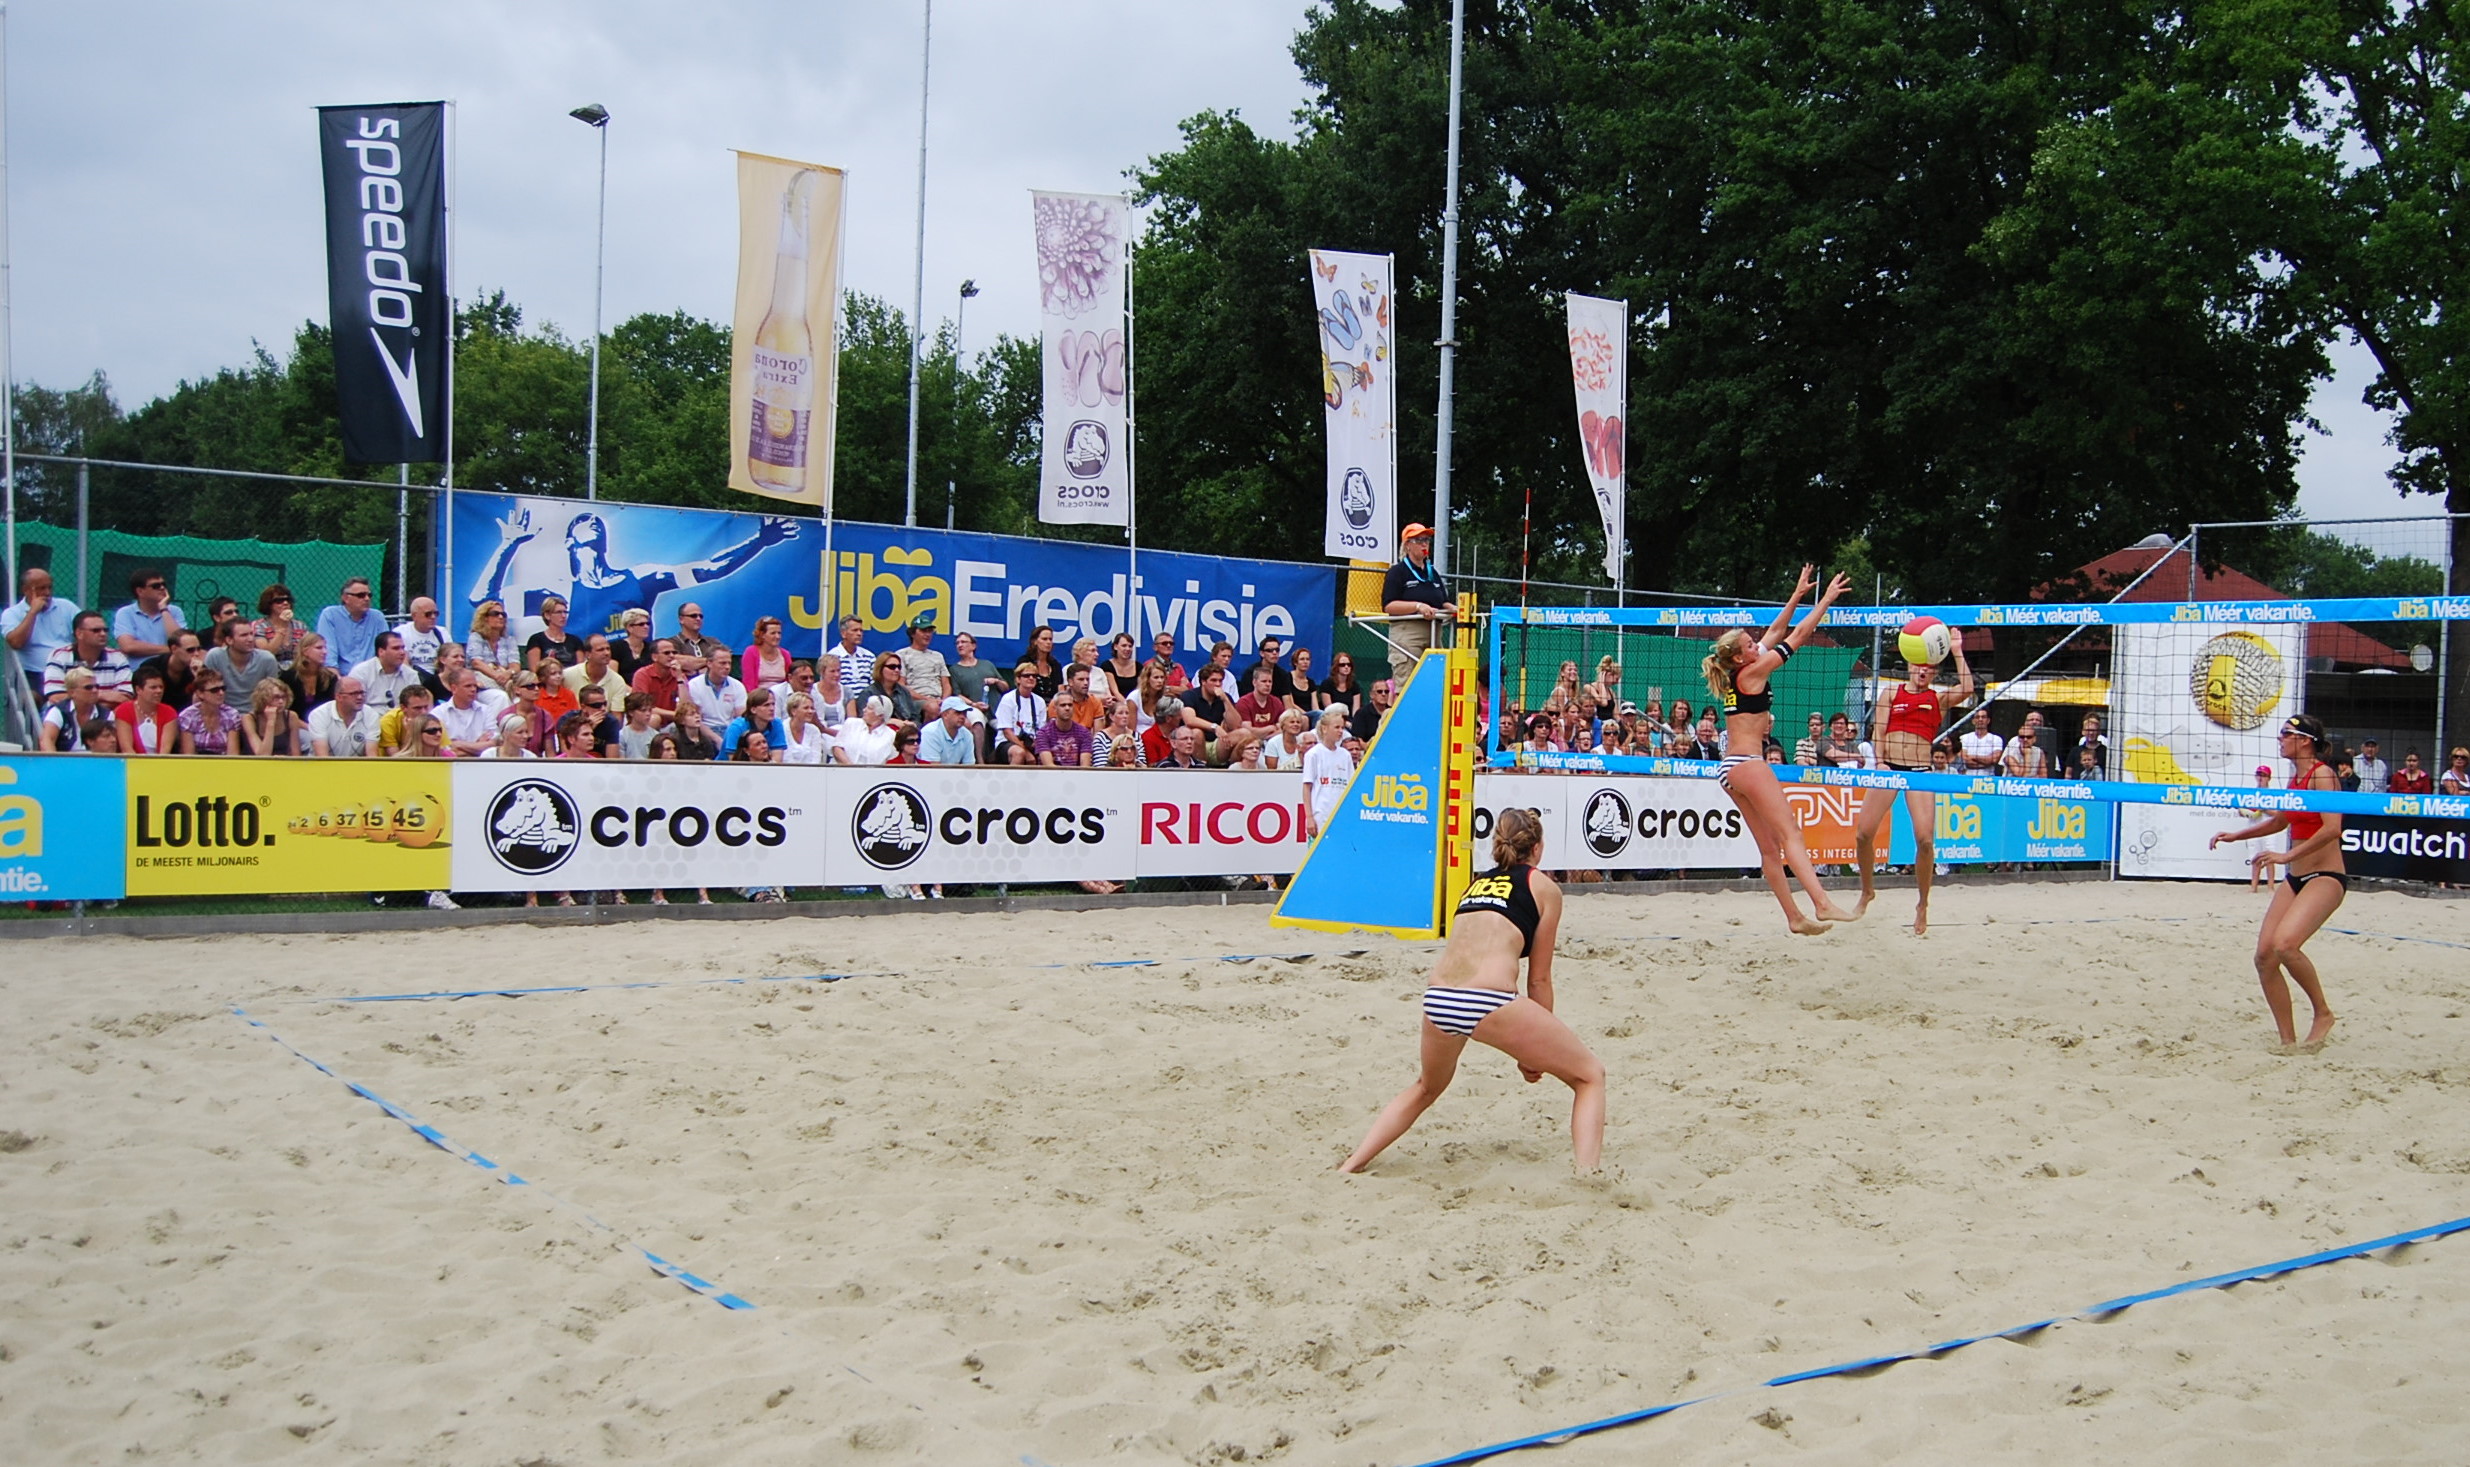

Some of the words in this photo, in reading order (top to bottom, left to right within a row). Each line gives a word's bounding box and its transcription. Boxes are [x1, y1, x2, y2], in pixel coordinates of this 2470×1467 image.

[346, 117, 424, 328] speedo
[789, 546, 951, 637] Jiba
[953, 559, 1296, 657] Eredivisie
[1570, 610, 1613, 624] vakantie.
[1680, 609, 1706, 625] Méér
[1708, 609, 1756, 625] vakantie.
[1833, 609, 1862, 624] Méér
[2005, 607, 2038, 624] Méér
[2042, 607, 2104, 624] vakantie.
[2204, 604, 2243, 622] Méér
[2245, 603, 2317, 621] vakantie.
[1564, 756, 1606, 770] vakantie.
[1673, 760, 1701, 776] Méér
[1825, 769, 1855, 786] Méér
[1856, 772, 1910, 789] vakantie.
[1361, 773, 1428, 811] Jiba
[1997, 779, 2031, 796] Méér
[2033, 781, 2095, 800] vakantie.
[2195, 788, 2236, 807] Méér
[2237, 791, 2307, 810] vakantie.
[1360, 809, 1385, 822] Méér
[1386, 811, 1429, 824] vakantie.
[1935, 793, 1982, 840] iba
[2423, 797, 2469, 817] Méér
[319, 815, 328, 826] 6
[337, 813, 357, 826] 37
[363, 810, 384, 826] 15
[393, 808, 425, 827] 45
[590, 805, 787, 847] crocs
[939, 807, 1105, 845] crocs
[1637, 808, 1741, 839] crocs
[2027, 797, 2086, 840] Jiba
[1942, 844, 1983, 859] vakantie.
[2027, 844, 2049, 858] Méér
[2050, 844, 2086, 858] vakantie.
[2341, 829, 2467, 860] swatch
[136, 858, 149, 867] DE
[153, 857, 193, 867] MEESTE
[197, 857, 259, 867] MILJONAIRS
